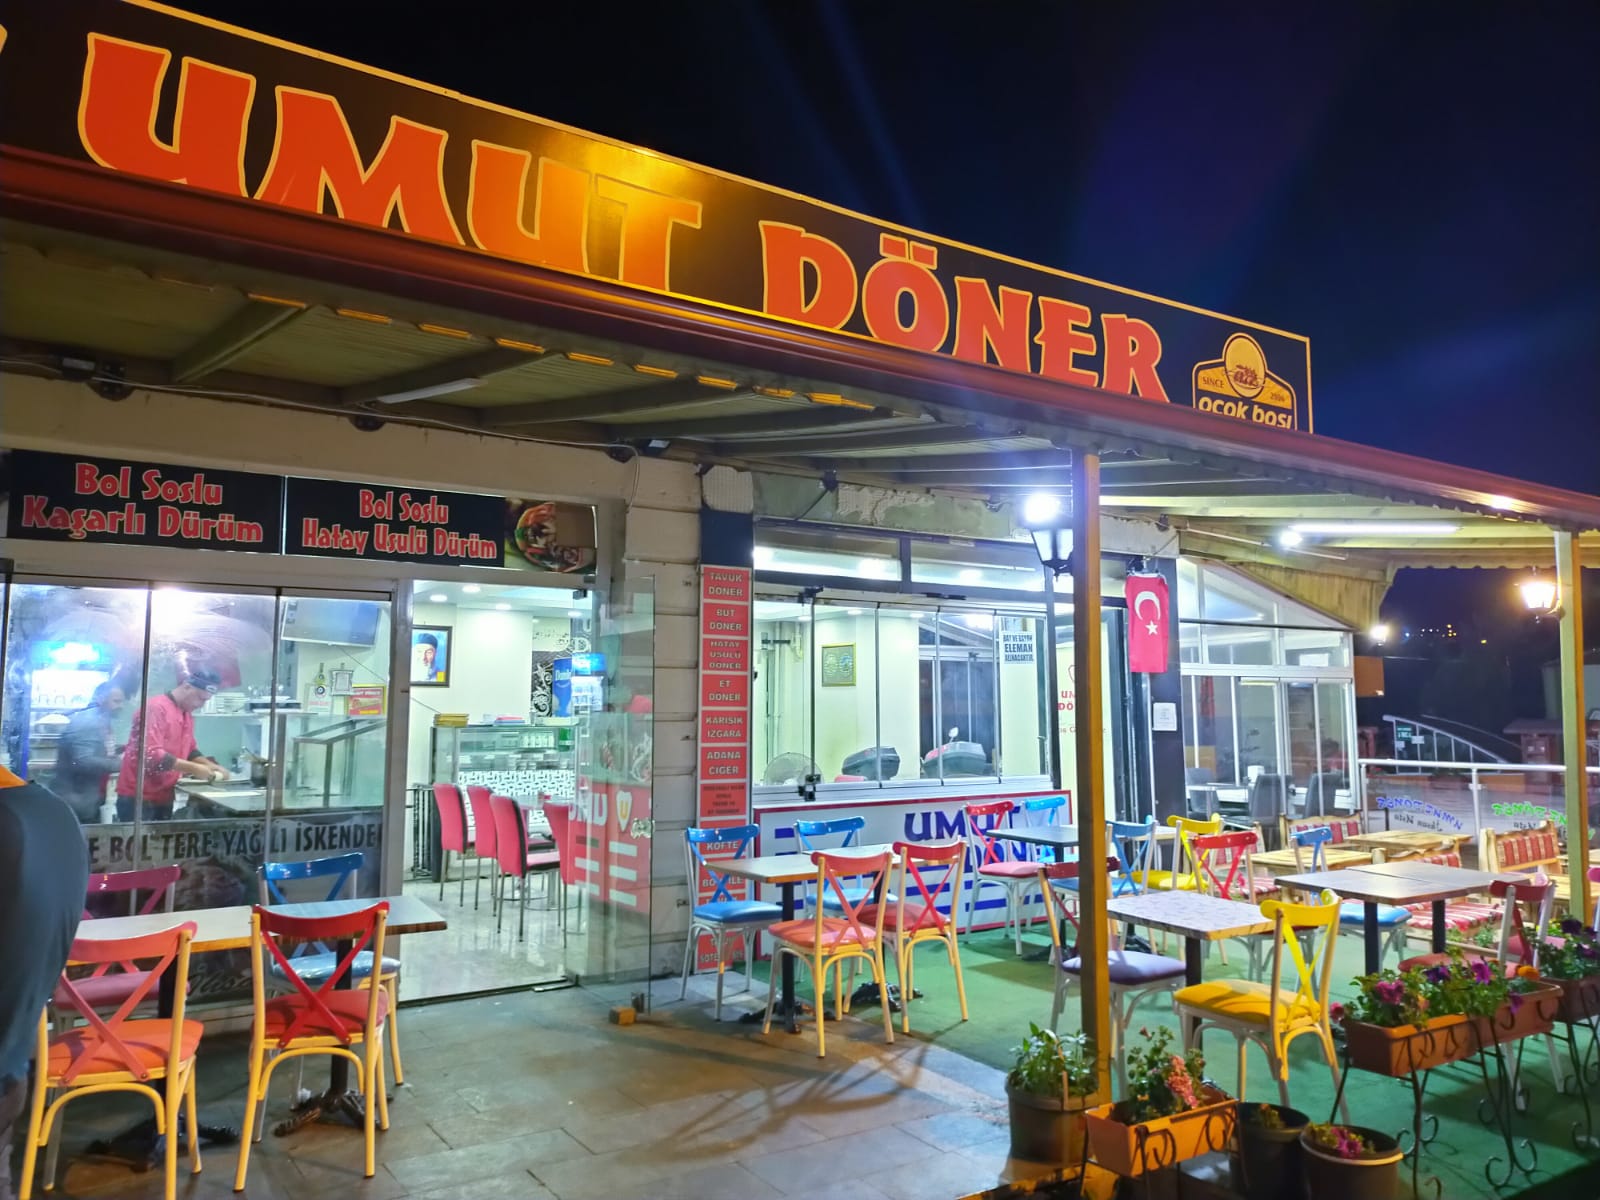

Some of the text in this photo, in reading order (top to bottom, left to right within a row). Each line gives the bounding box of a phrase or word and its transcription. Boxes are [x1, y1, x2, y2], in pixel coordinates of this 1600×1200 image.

[78, 32, 1171, 404] UMUT DÖNER
[1202, 376, 1225, 388] SINCE
[75, 462, 223, 505] Bol Soslu
[21, 495, 264, 543] Kaşarlı Dürüm
[359, 489, 449, 525] Bol Soslu
[302, 517, 498, 560] Hatay Usulü Dürüm
[1004, 643, 1033, 653] ELEMAN
[719, 679, 731, 688] ET
[706, 751, 741, 760] ADANA
[109, 834, 153, 864] BOL
